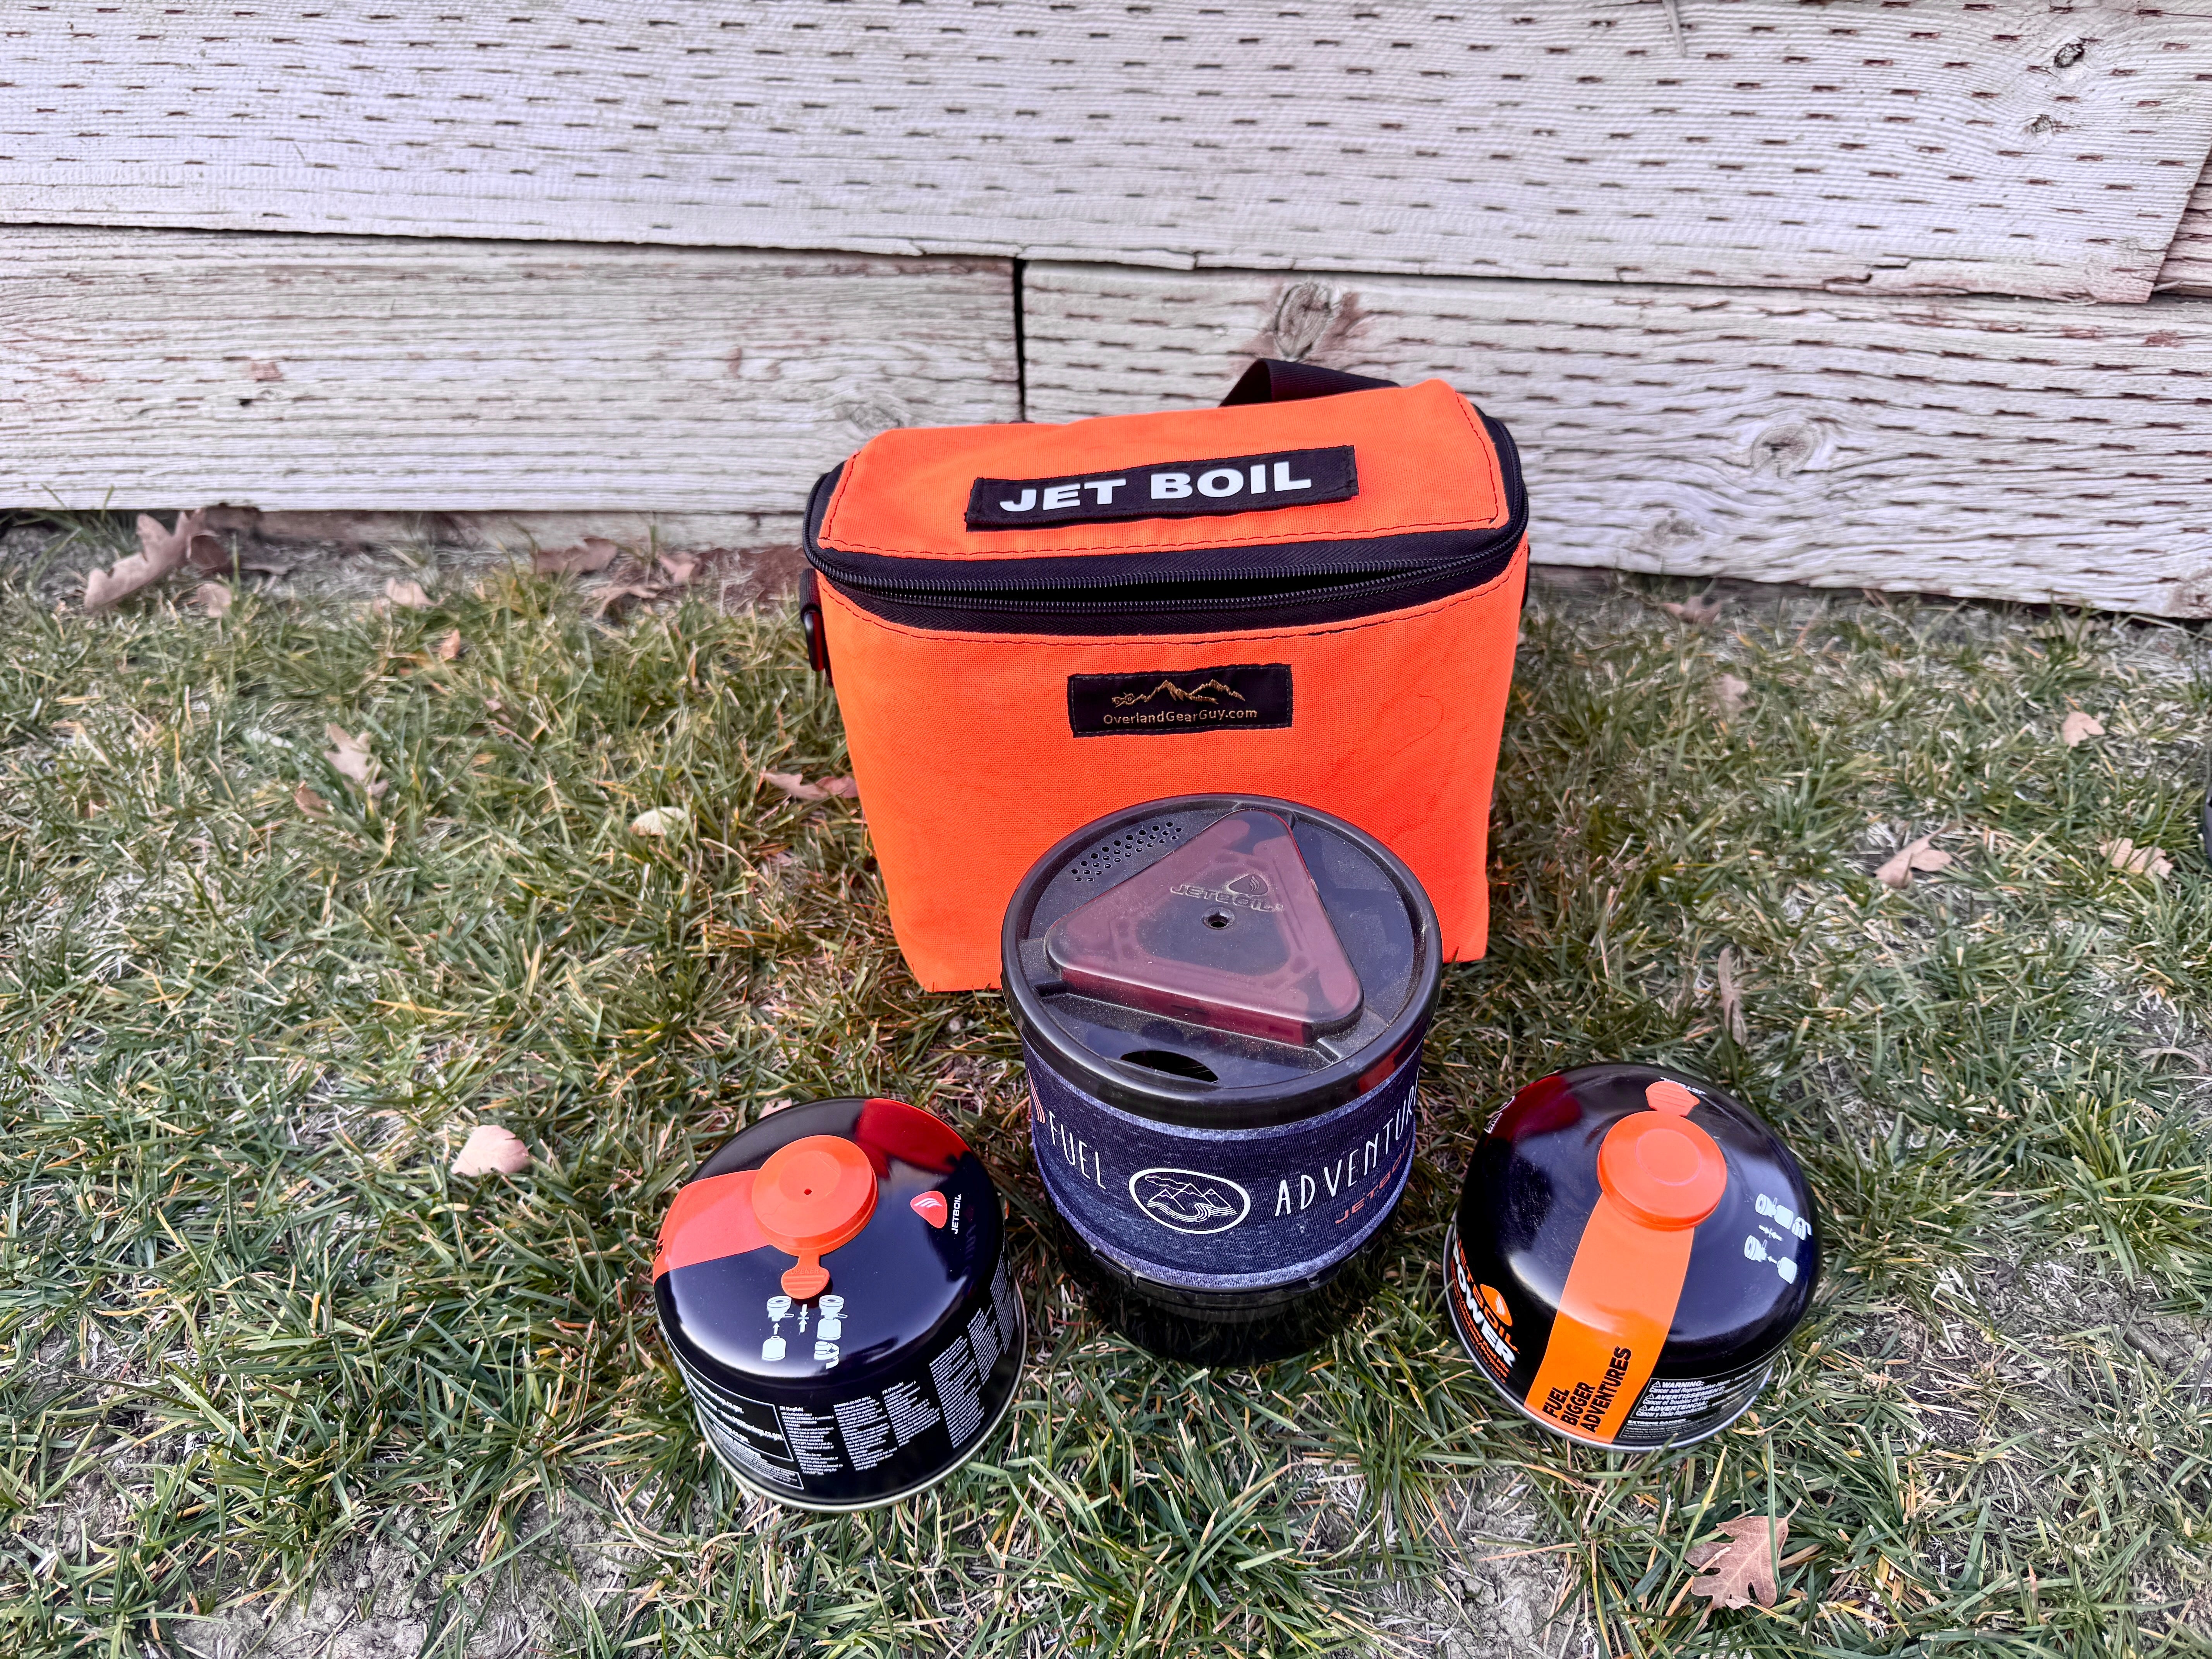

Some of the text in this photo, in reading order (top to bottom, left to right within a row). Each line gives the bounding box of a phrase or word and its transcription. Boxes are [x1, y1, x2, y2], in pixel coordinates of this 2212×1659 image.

[999, 461, 1312, 512] JET BOIL
[1103, 709, 1257, 725] OverlandGearGuy.com
[1049, 1110, 1106, 1190] FUEL
[951, 1194, 962, 1235] JETBOIL
[1542, 1387, 1570, 1418] FUEL
[1560, 1382, 1596, 1427] BIGGER
[1580, 1346, 1632, 1433] ADVENTURES
[1662, 1380, 1705, 1388] WARNING:
